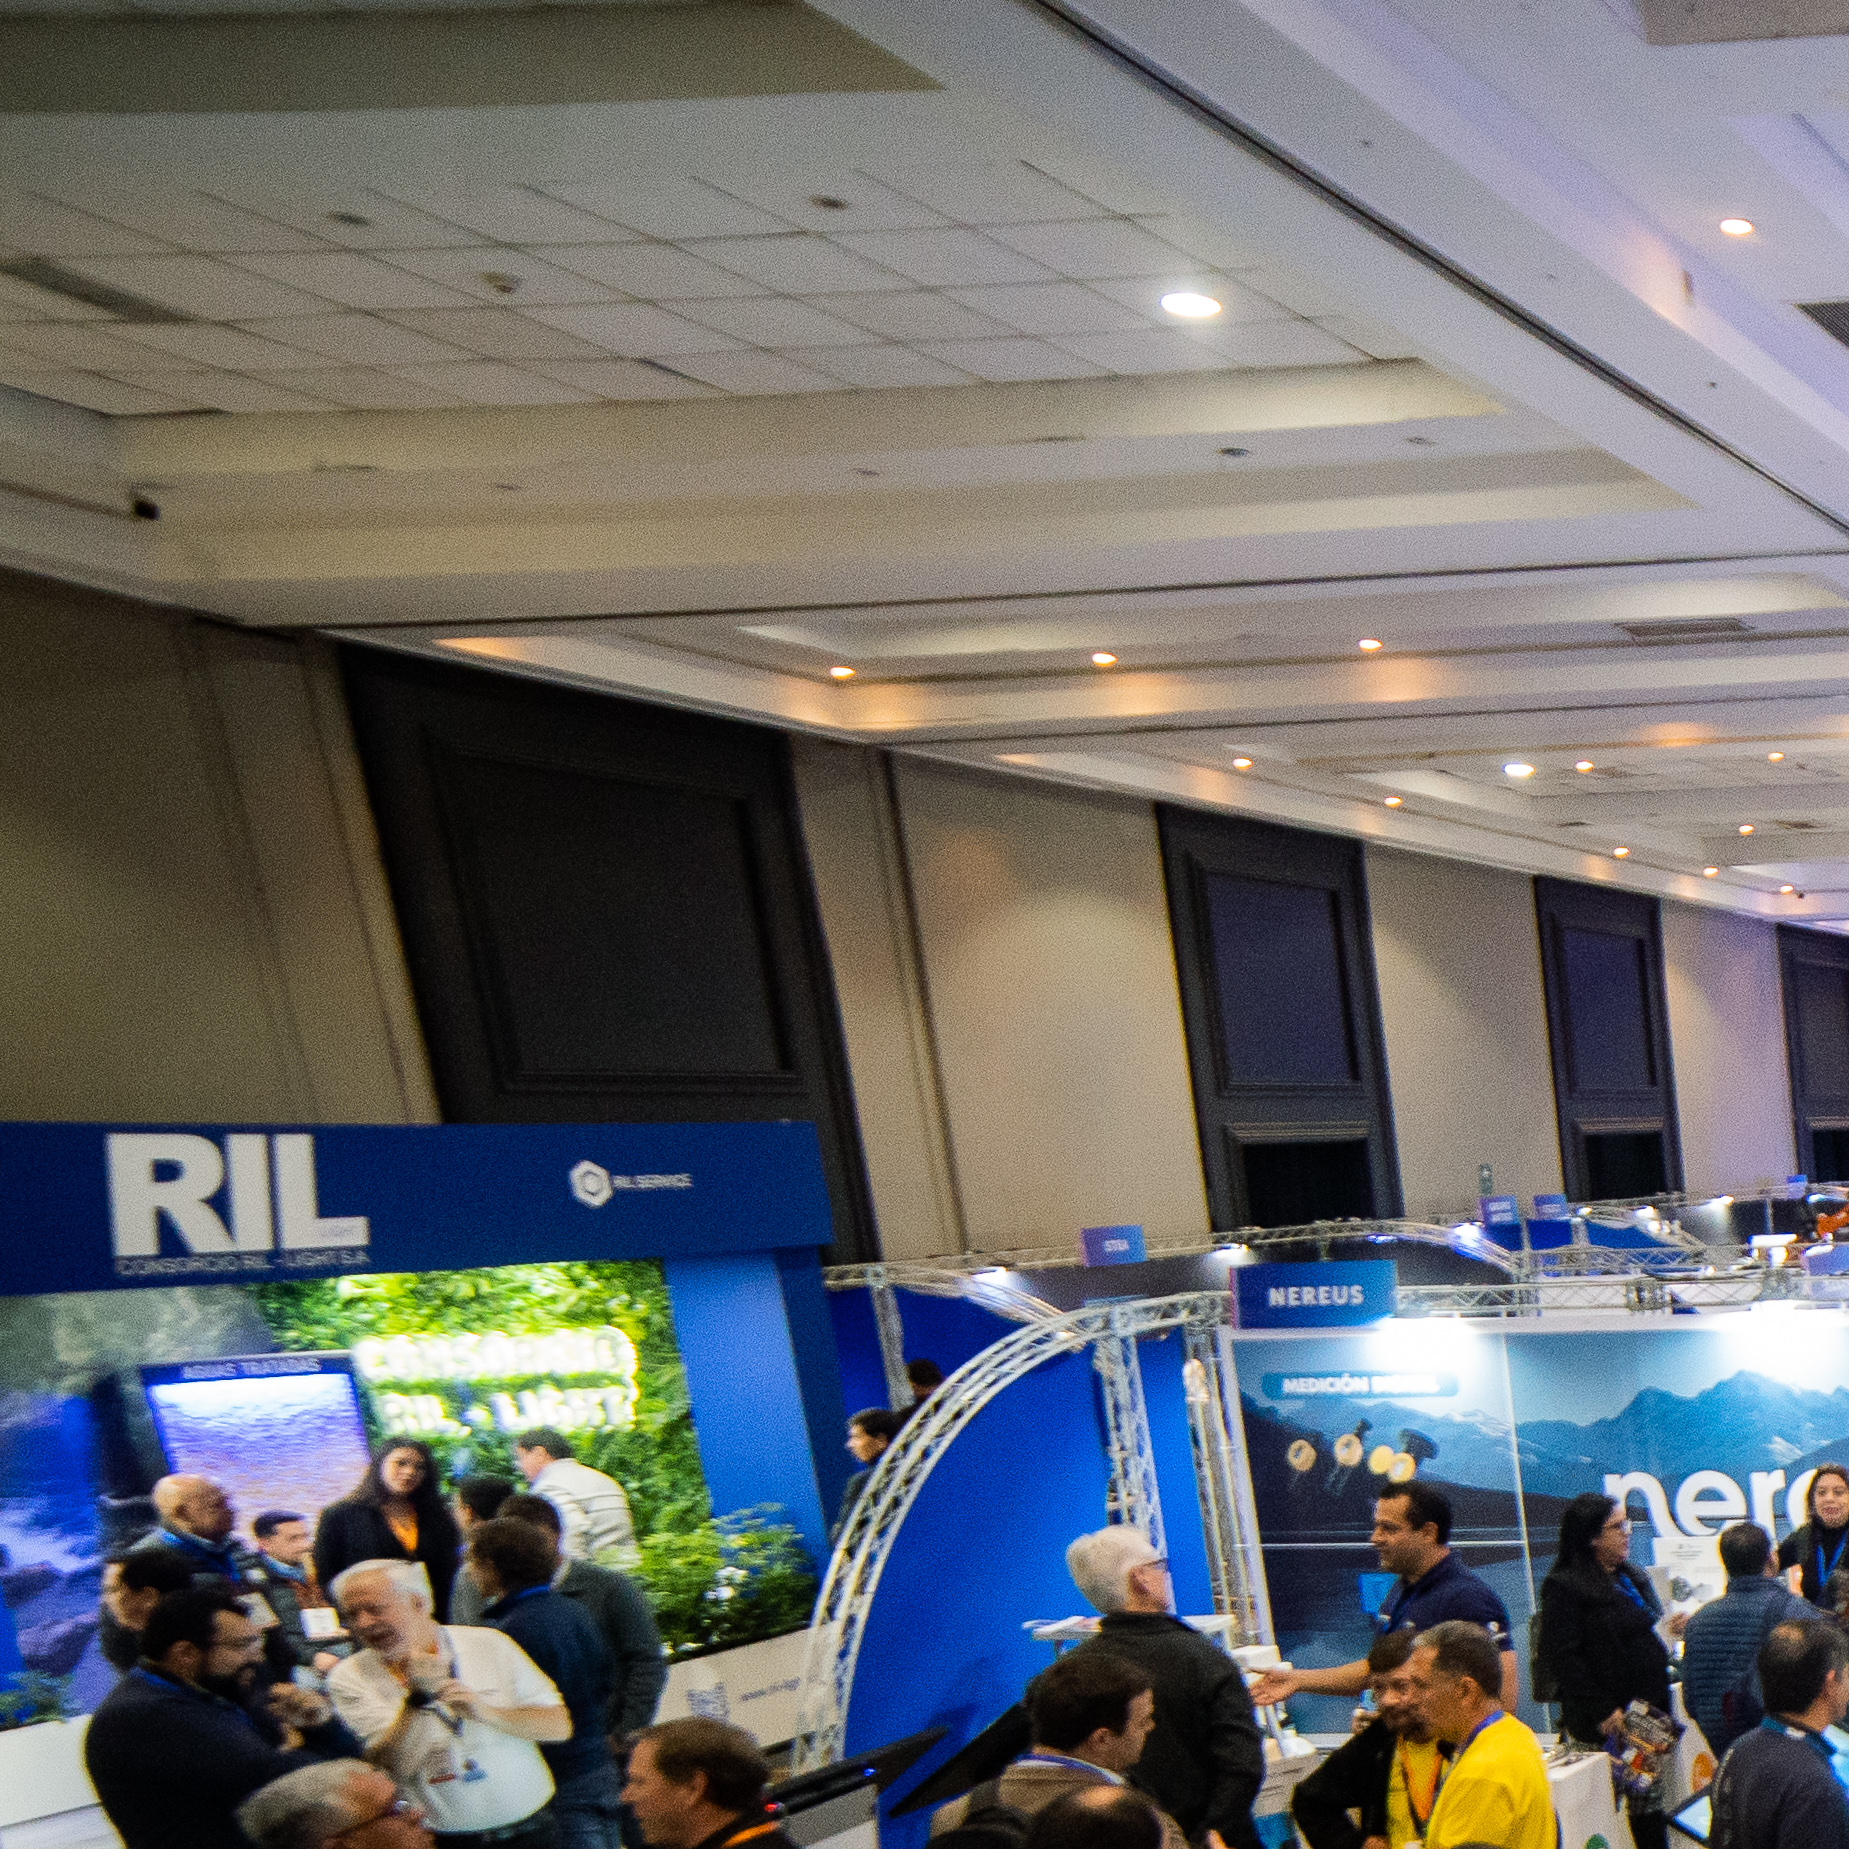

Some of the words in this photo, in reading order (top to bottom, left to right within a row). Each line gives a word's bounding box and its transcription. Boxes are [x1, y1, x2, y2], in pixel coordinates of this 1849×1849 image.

[104, 1132, 371, 1258] RIL
[116, 1256, 240, 1277] CONSORCIO
[1268, 1284, 1365, 1308] NEREUS
[1281, 1373, 1370, 1394] MEDICIÓN
